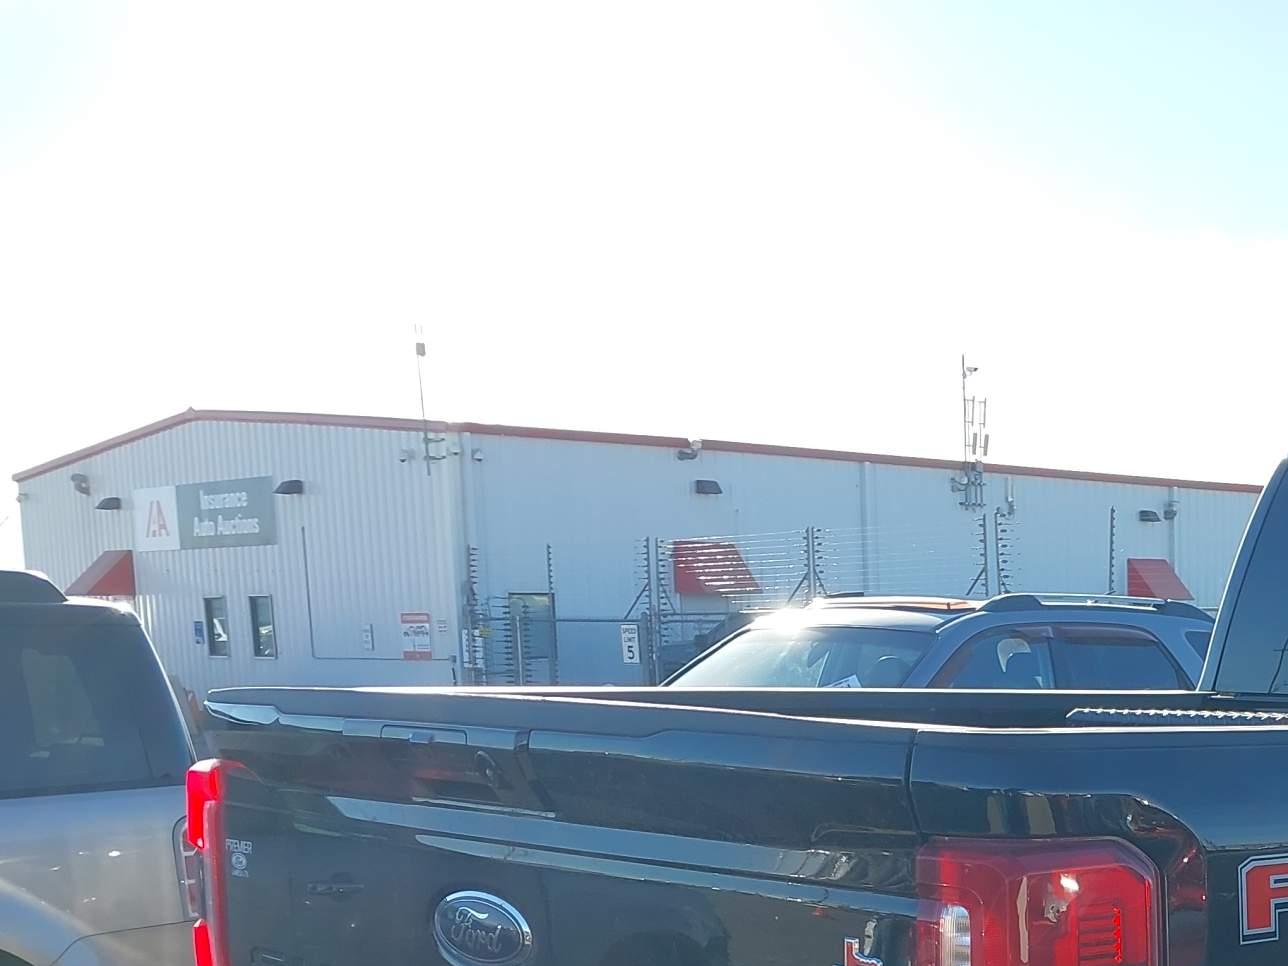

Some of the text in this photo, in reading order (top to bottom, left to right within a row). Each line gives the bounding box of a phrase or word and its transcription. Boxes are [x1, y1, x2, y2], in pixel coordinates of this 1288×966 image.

[199, 489, 249, 511] Insurance
[193, 513, 260, 537] Auto Auctions
[627, 645, 635, 660] 5
[451, 906, 502, 952] Ford
